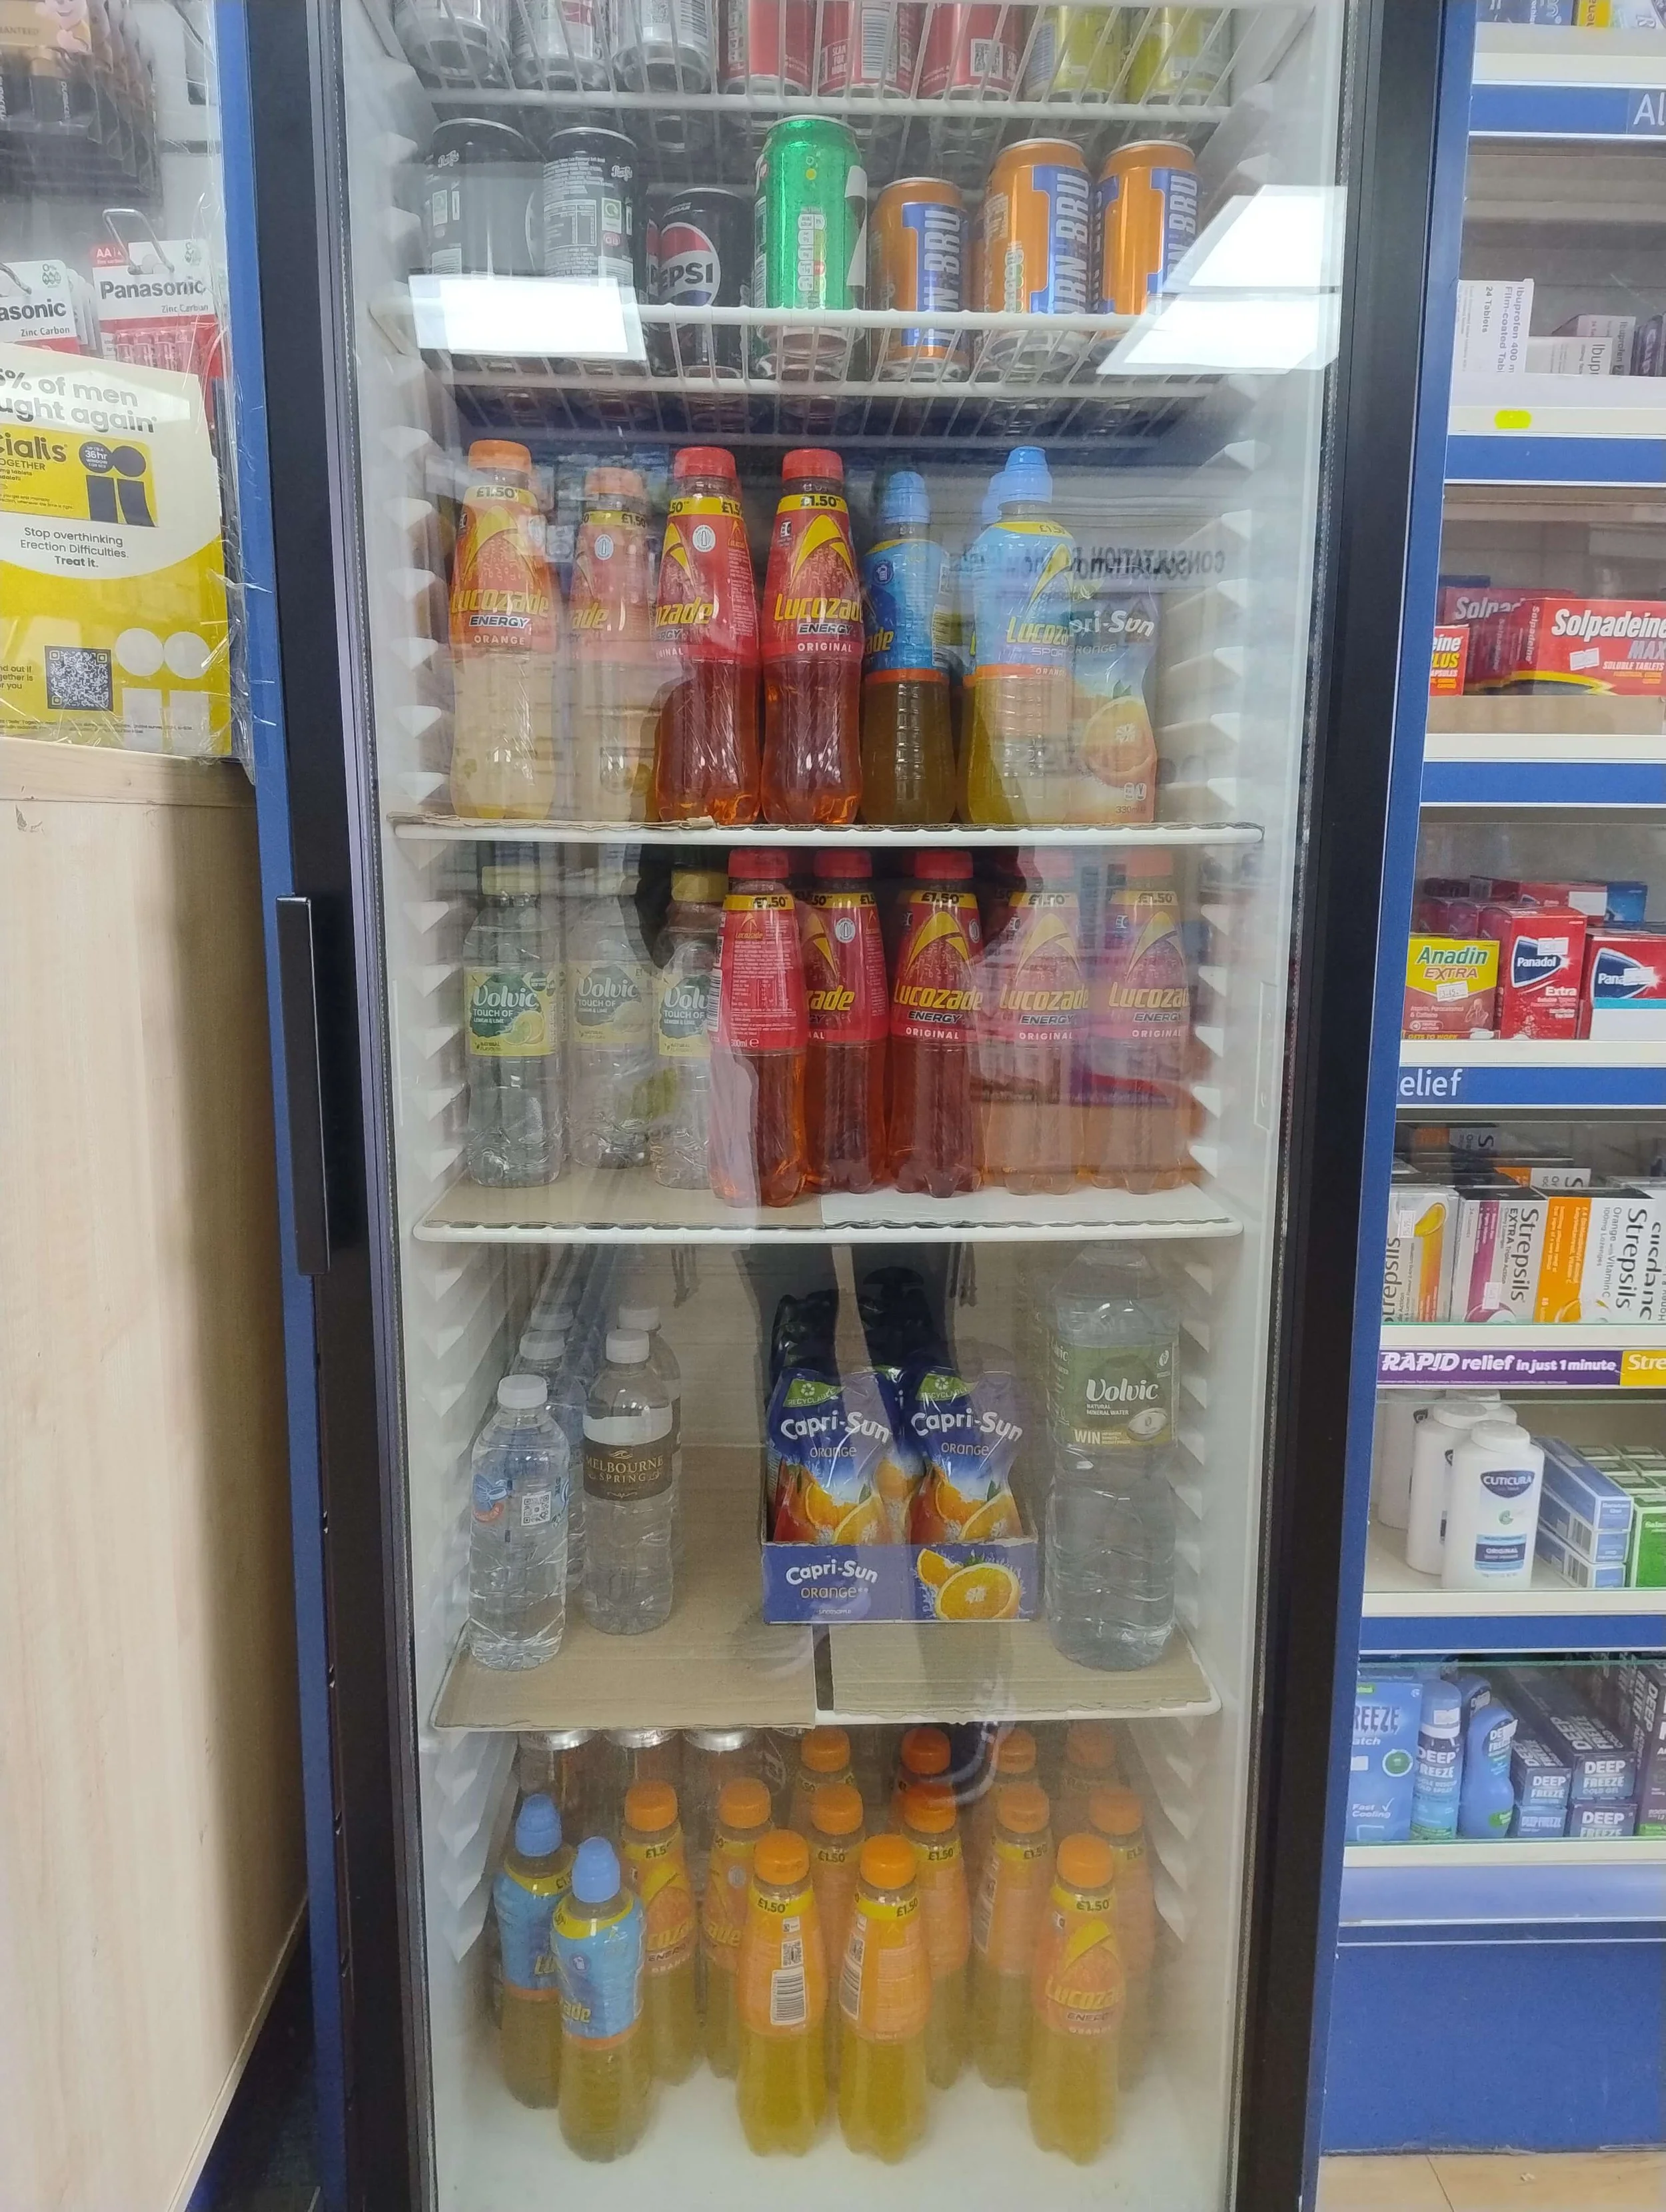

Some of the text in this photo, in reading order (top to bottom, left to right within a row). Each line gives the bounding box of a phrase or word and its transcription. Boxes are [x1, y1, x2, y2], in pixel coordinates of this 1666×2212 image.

[97, 249, 112, 258] AA
[100, 275, 206, 299] Panasonic
[161, 304, 209, 313] Zinc Carbon
[1481, 286, 1493, 334] 24 Tablets
[1512, 286, 1525, 336] Ibuprofen
[1499, 286, 1513, 351] Film-coated
[21, 325, 70, 337] Zinc Carbon
[38, 376, 138, 407] of men
[85, 450, 108, 460] 36hr
[476, 488, 516, 499] £1.50
[800, 496, 838, 508] £1.50
[25, 527, 123, 548] Stop overthinking
[20, 539, 129, 558] Erection Difficulties.
[55, 555, 99, 568] Treat it.
[450, 589, 550, 617] Lucozade
[468, 616, 530, 628] ENERGY
[797, 623, 853, 634] ENERGY
[474, 634, 525, 646] ORANGE
[1525, 605, 1541, 664] Solpadeine
[797, 642, 852, 653] ORIGINAL
[922, 892, 960, 904] £1.50
[1416, 945, 1489, 965] Anadin
[1517, 957, 1557, 967] Panadol
[1423, 966, 1478, 981] EXTRA
[578, 977, 638, 998] Volvic
[894, 977, 983, 1011] Lucozade
[1545, 986, 1578, 997] Extra
[472, 985, 538, 1007] Volvic
[473, 1008, 500, 1017] TOUCH
[664, 1009, 692, 1019] TOUCH
[908, 1011, 963, 1023] ENERGY
[1020, 1014, 1075, 1025] ENERGY
[906, 1026, 959, 1040] ORIGINAL
[1019, 1031, 1073, 1041] ORIGINAL
[1132, 1029, 1182, 1038] ORIGINAL
[1399, 1068, 1463, 1097] elief
[1506, 1207, 1519, 1245] EXTRA
[1609, 1207, 1622, 1242] Orange
[1597, 1207, 1611, 1267] 100mg Lozenges
[1511, 1207, 1539, 1302] Strepsils
[1615, 1207, 1648, 1309] Strepsils
[1603, 1255, 1616, 1291] Vitamin
[1380, 1351, 1617, 1374] RAPID relief in just 1 minute
[788, 1387, 837, 1406] RECYCLABLE
[1086, 1377, 1160, 1402] Volvic
[780, 1409, 890, 1444] Capri-Sun
[911, 1408, 1023, 1442] Capri-Sun
[1073, 1428, 1102, 1444] WIN
[586, 1454, 664, 1474] MELBOURNE
[599, 1472, 646, 1483] SPRING
[1483, 1475, 1532, 1486] CUTICURA
[786, 1558, 878, 1586] Capri-Sun
[1419, 1746, 1457, 1764] DEEP
[1584, 1760, 1626, 1774] DEEP
[1533, 1776, 1566, 1786] DEEP
[1583, 1776, 1625, 1789] FREEZE
[1531, 1788, 1565, 1798] FREEZE
[1351, 1810, 1392, 1819] Cooling
[1581, 1811, 1625, 1825] DEEP
[817, 1850, 846, 1864] £1.50
[927, 1848, 954, 1862] £1.50
[757, 1896, 786, 1914] £1.50
[896, 1898, 918, 1918] £1.50
